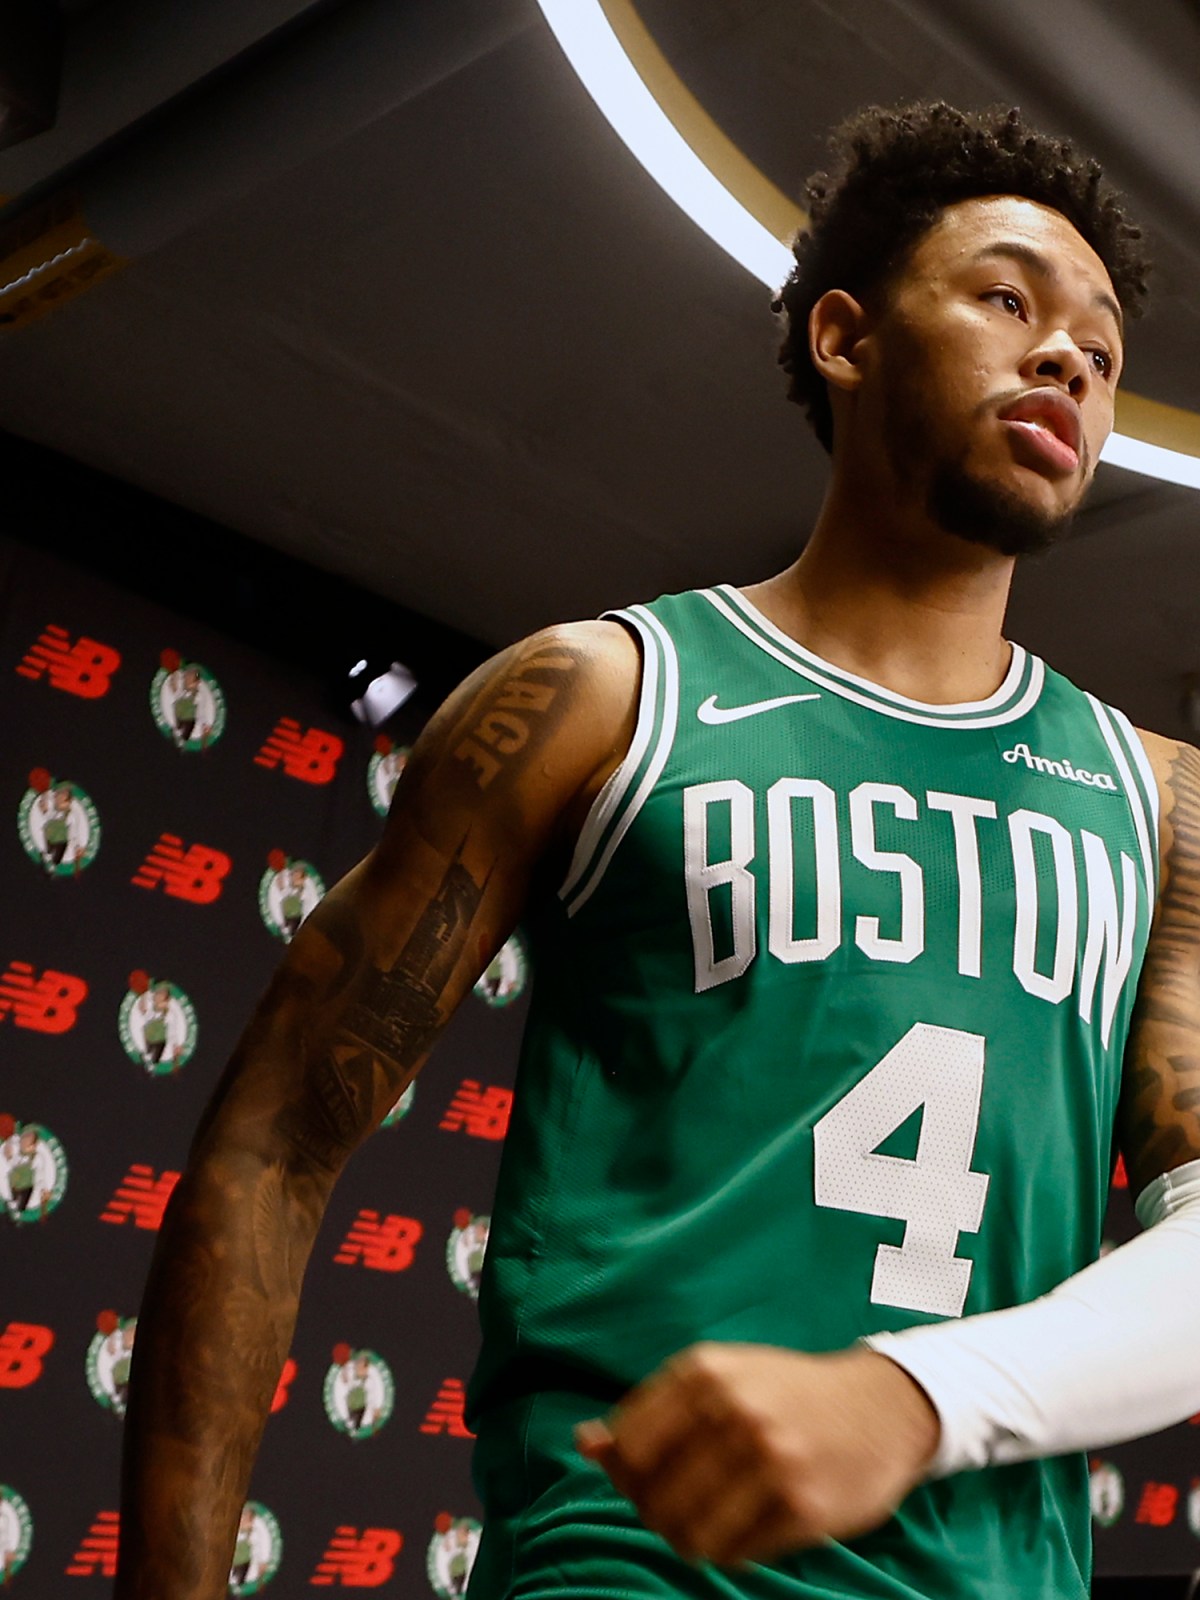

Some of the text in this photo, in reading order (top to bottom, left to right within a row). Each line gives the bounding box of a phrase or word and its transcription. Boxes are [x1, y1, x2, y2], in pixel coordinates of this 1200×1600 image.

[1002, 743, 1118, 790] Amica
[683, 777, 1137, 1051] BOSTON
[813, 1022, 990, 1318] 4
